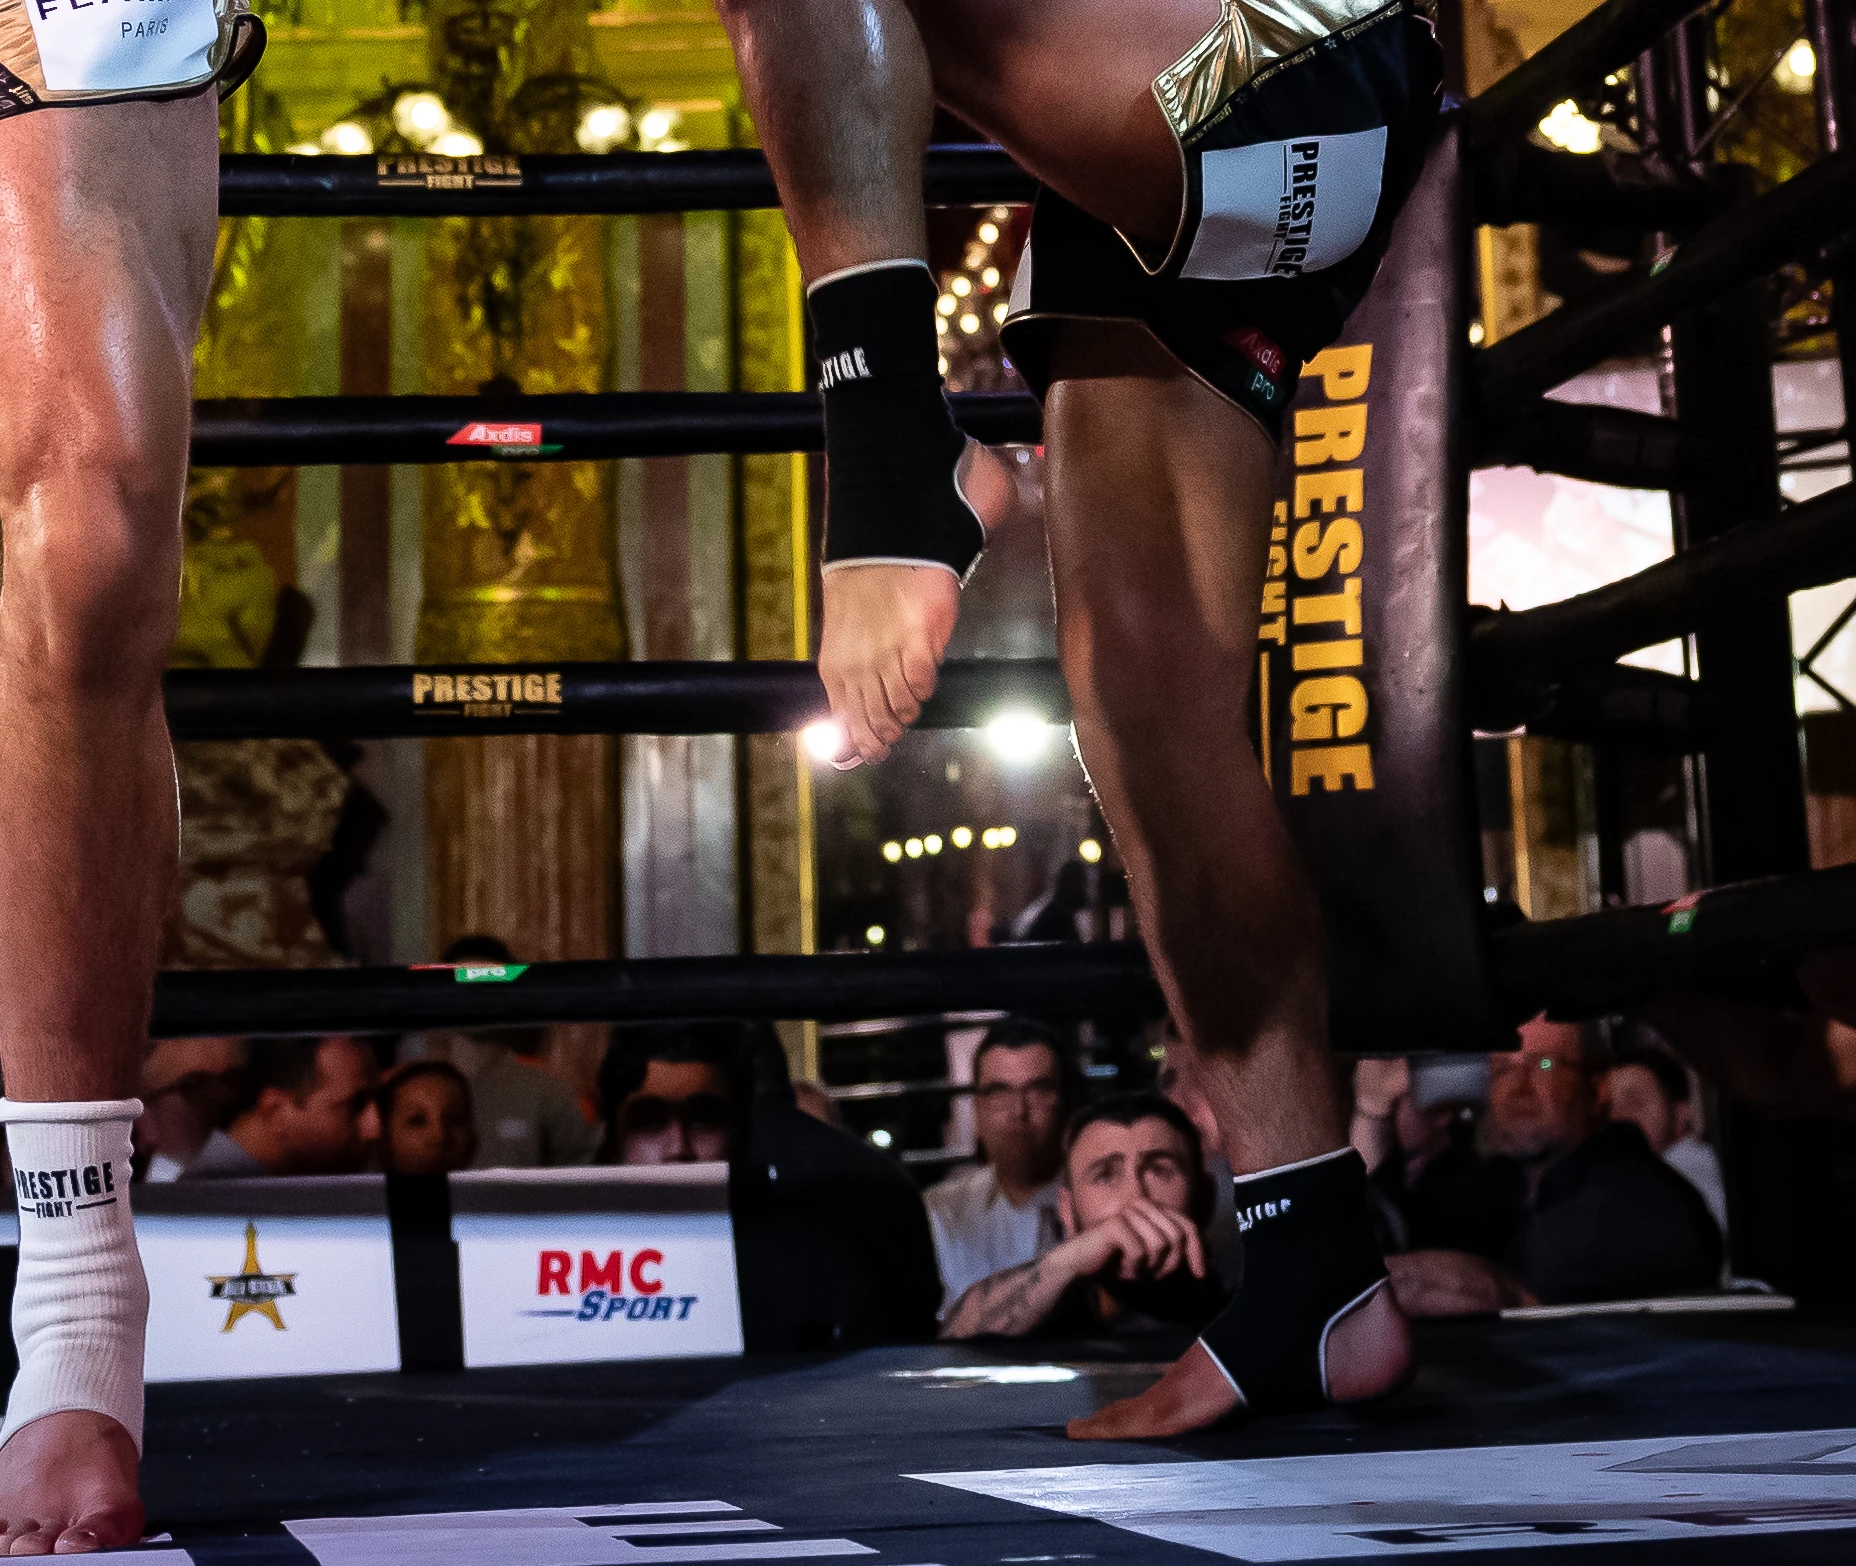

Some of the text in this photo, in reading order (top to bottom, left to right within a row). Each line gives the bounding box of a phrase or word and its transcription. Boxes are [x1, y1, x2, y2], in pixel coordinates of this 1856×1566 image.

[121, 14, 169, 39] PARIS
[1272, 141, 1320, 277] PRESTIGE
[1274, 195, 1292, 240] FIGHT
[1250, 371, 1275, 401] pro
[1289, 343, 1376, 797] PRESTIGE
[411, 672, 564, 705] PRESTIGE
[536, 1249, 665, 1296] RMC
[576, 1288, 700, 1323] SPORT
